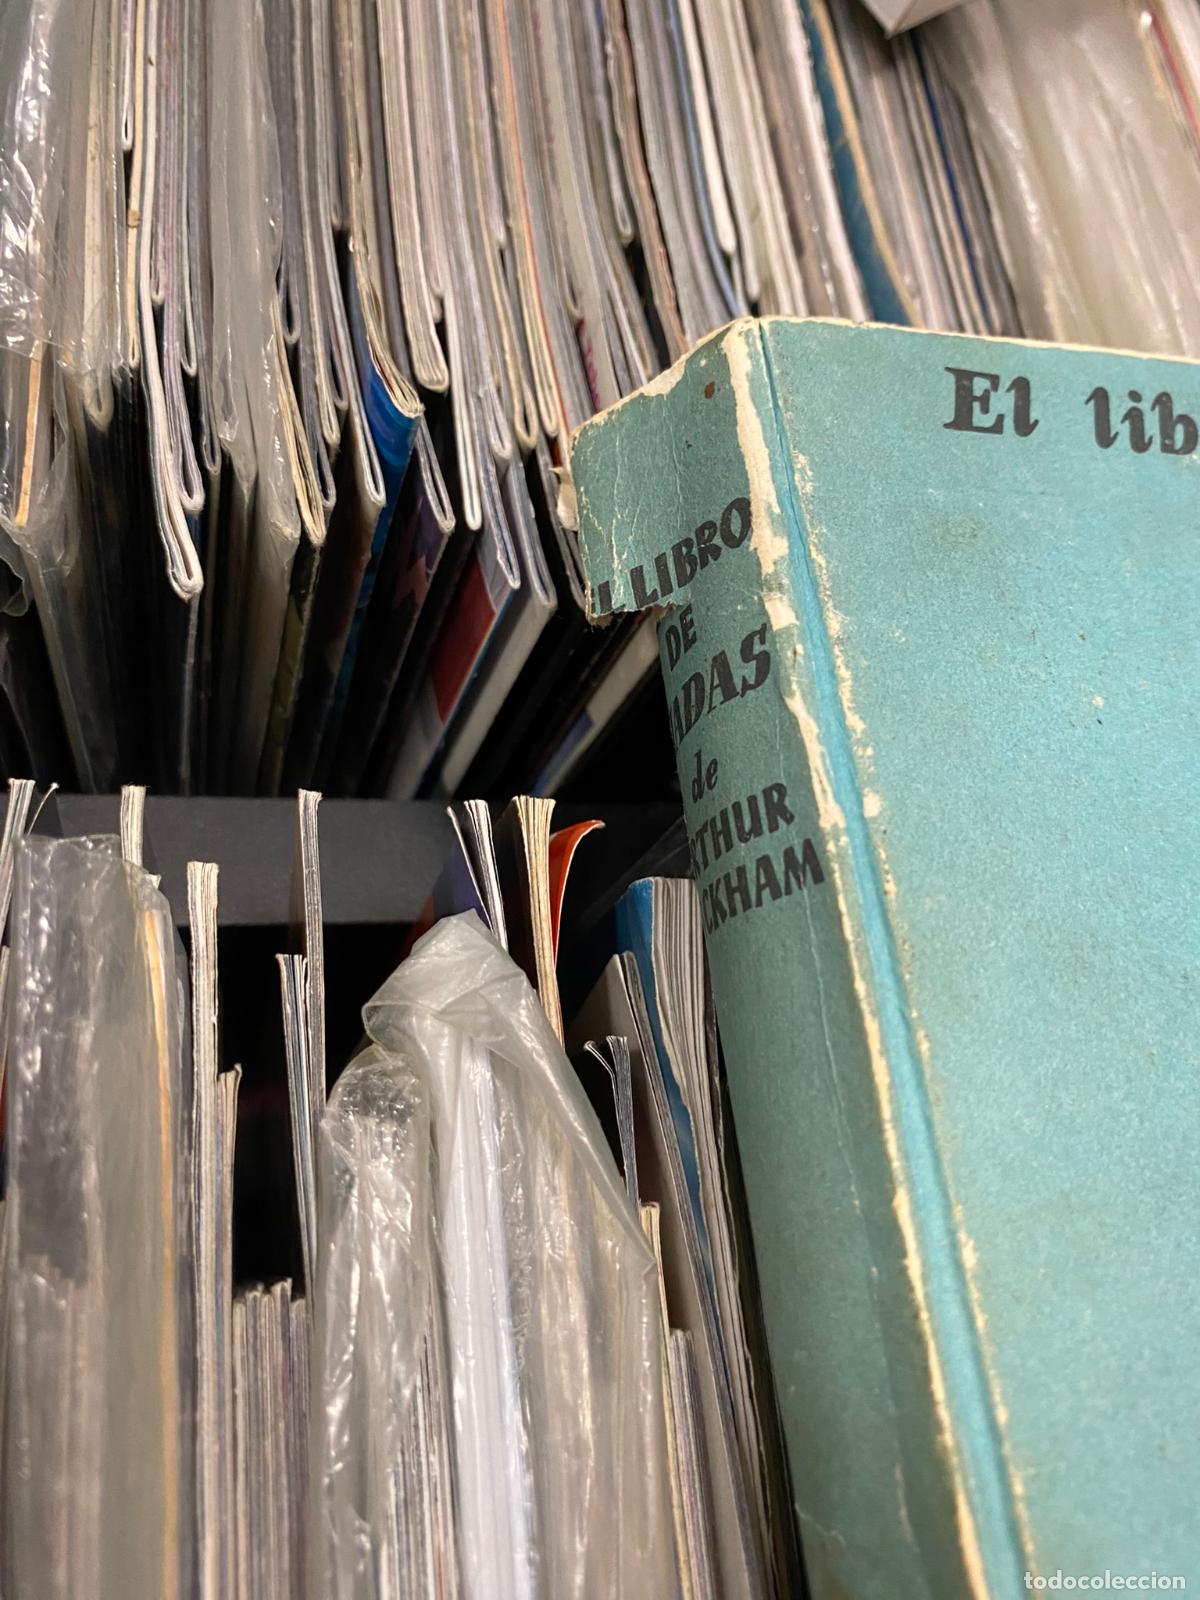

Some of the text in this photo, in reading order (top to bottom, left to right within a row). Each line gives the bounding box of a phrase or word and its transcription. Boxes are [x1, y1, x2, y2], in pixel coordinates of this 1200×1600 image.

[943, 366, 1039, 437] El
[590, 497, 753, 614] L LIBRO
[665, 603, 698, 671] DE
[668, 623, 771, 752] ADAS
[691, 750, 718, 804] de
